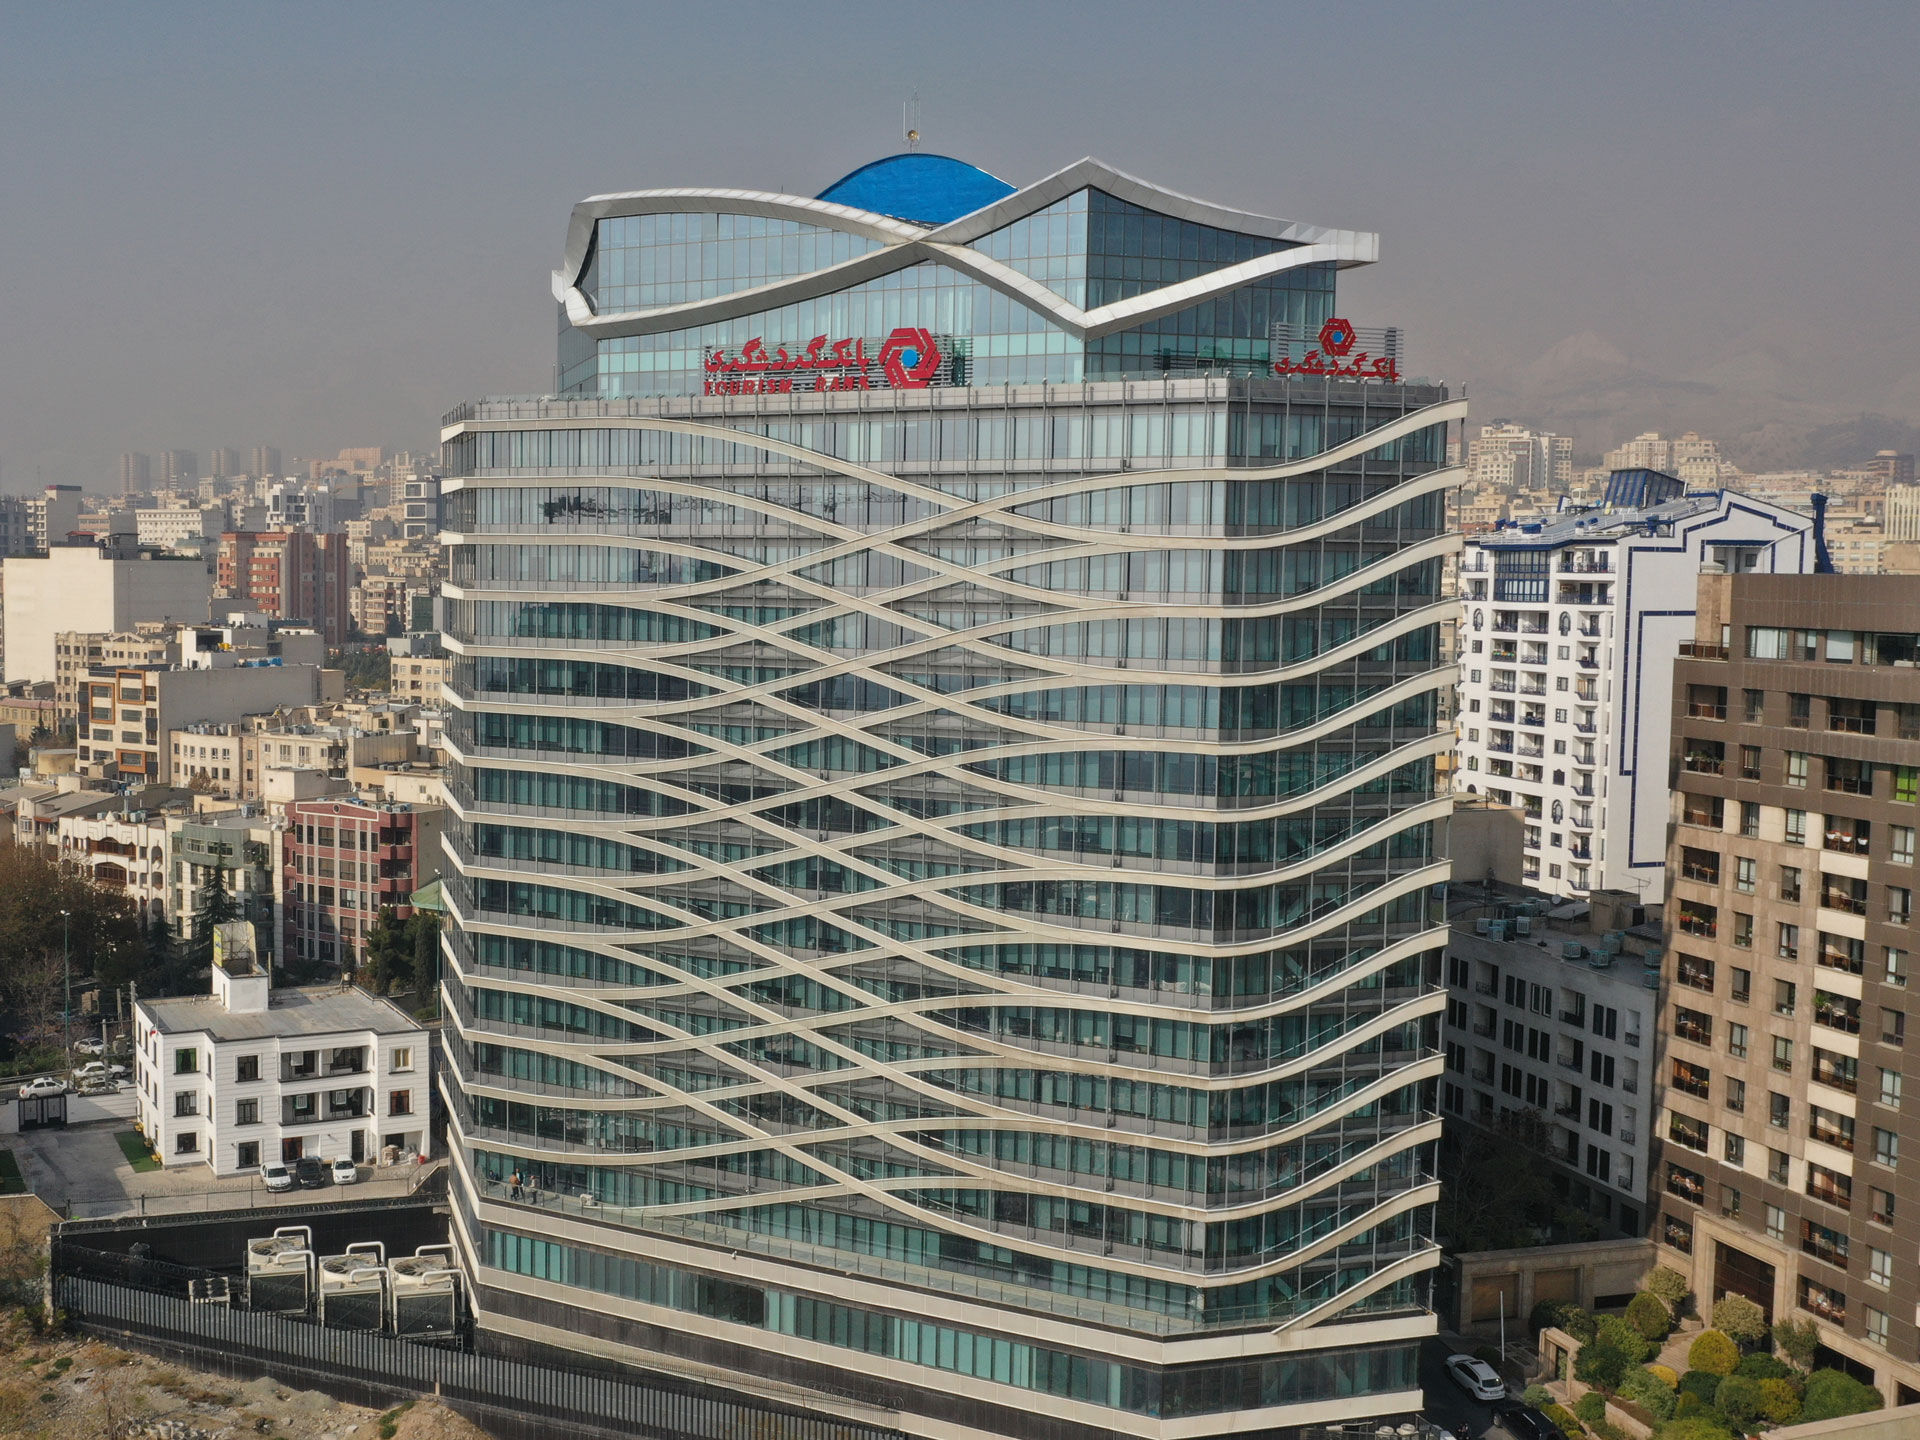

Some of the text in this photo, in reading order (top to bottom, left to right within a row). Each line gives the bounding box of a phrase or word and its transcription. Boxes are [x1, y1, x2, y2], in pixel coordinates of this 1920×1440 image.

[705, 334, 870, 373] بانک گردشگری
[1359, 357, 1400, 383] بانک
[704, 376, 870, 396] TOURISM BANK
